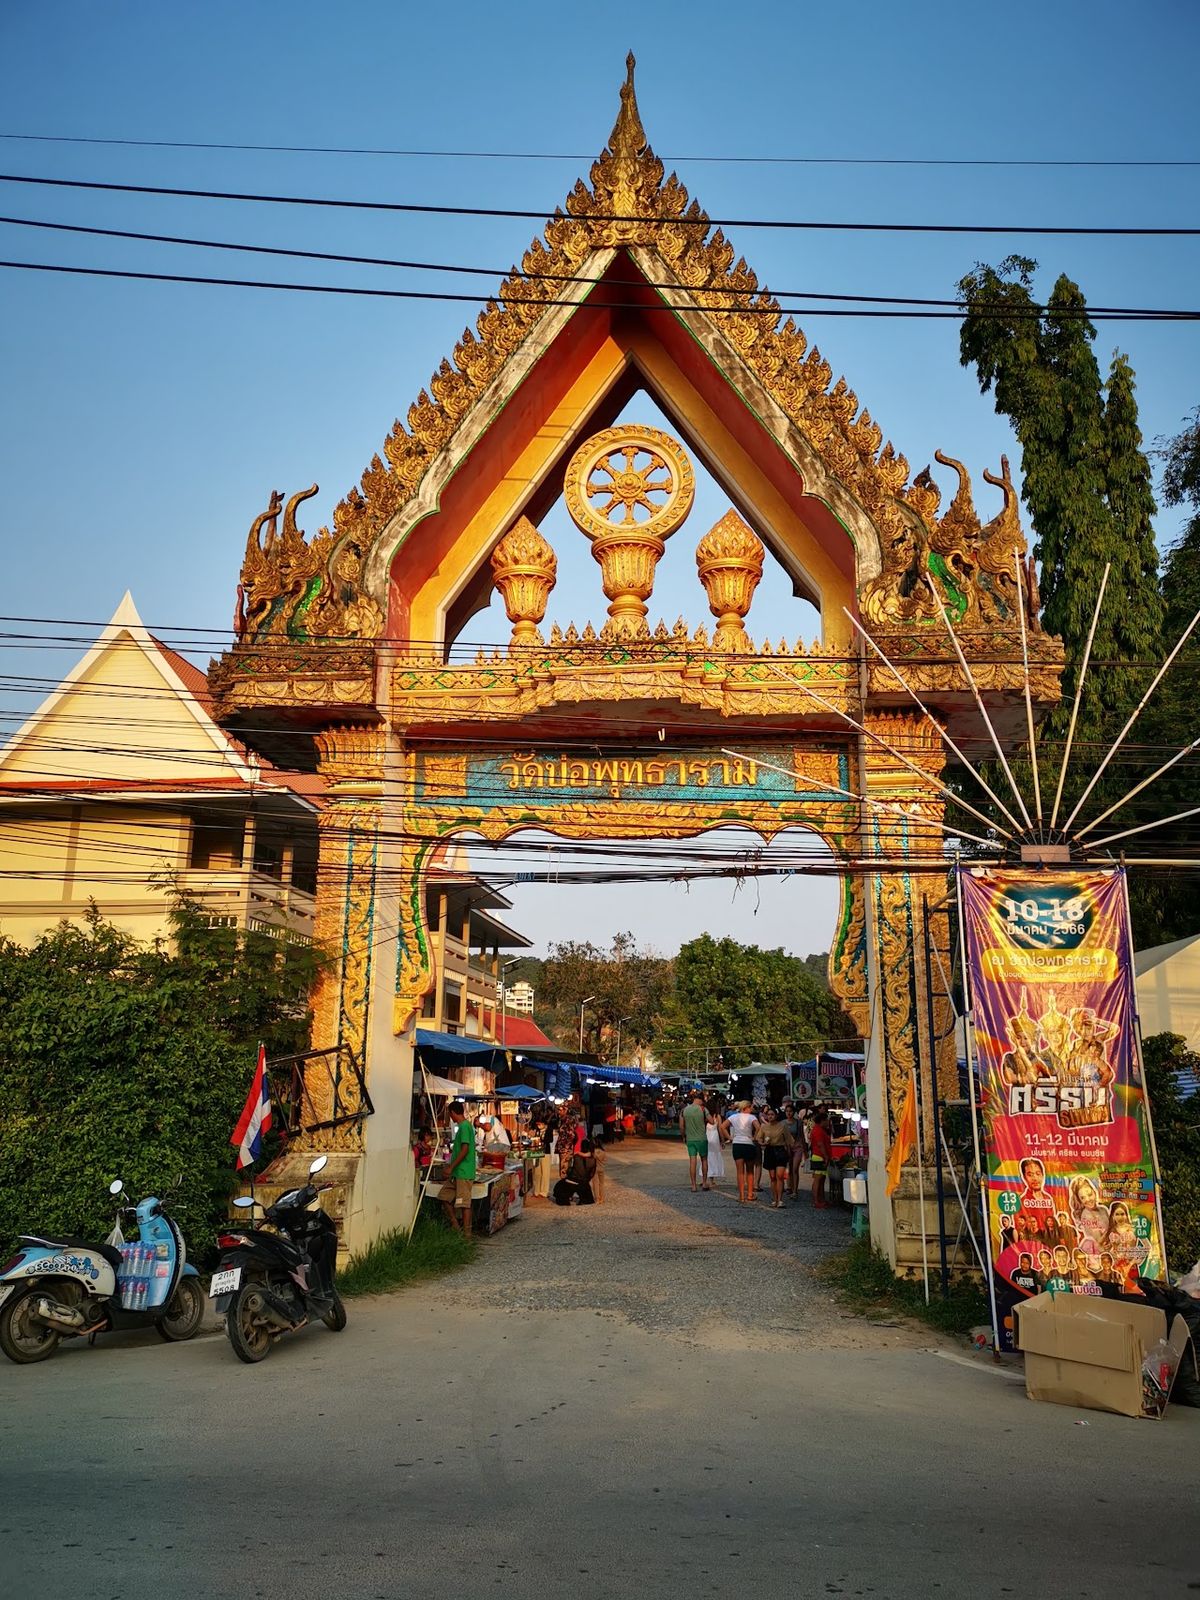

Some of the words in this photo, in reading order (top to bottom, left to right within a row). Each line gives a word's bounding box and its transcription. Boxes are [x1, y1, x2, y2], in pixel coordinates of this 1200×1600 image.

[501, 749, 758, 798] วัดบ่อพุทธาราม
[1005, 899, 1085, 921] 10-18
[1053, 924, 1085, 935] 2566
[1025, 1134, 1062, 1146] 11-12
[1068, 1132, 1108, 1146] มีนาคม
[1002, 1192, 1016, 1203] 13
[1137, 1218, 1147, 1228] 16
[1050, 1279, 1065, 1291] 18
